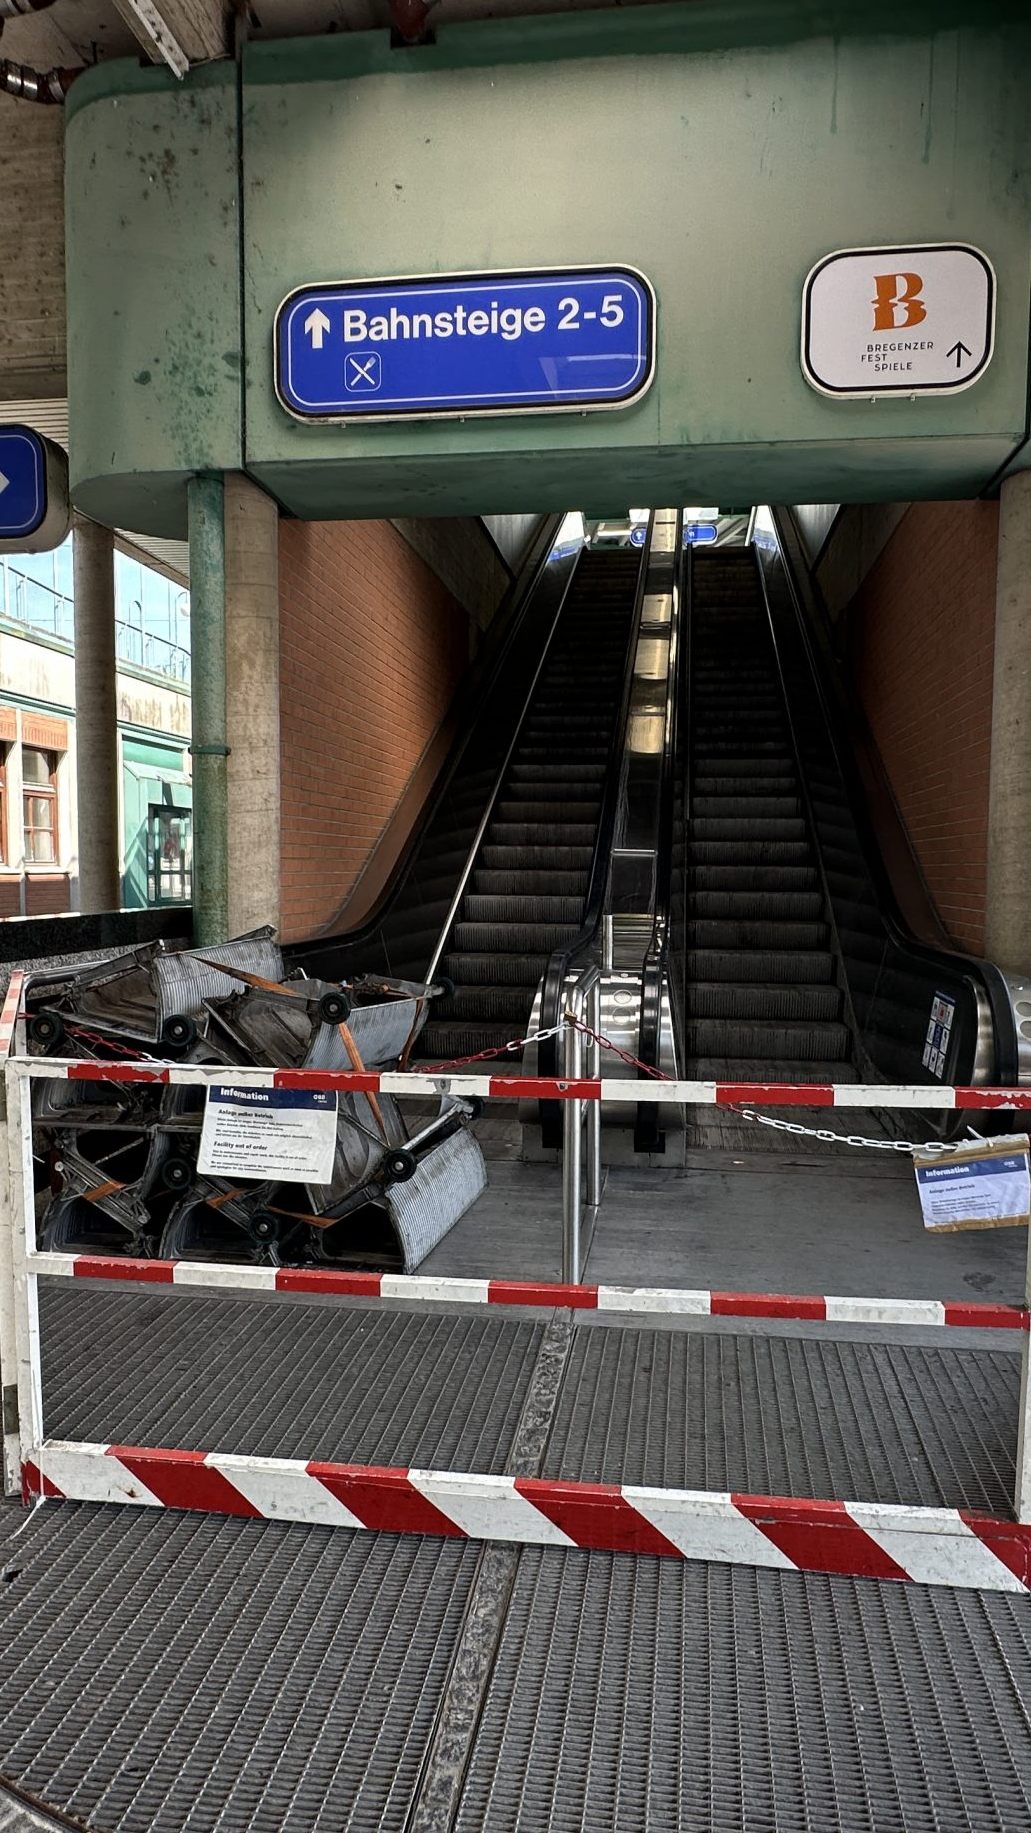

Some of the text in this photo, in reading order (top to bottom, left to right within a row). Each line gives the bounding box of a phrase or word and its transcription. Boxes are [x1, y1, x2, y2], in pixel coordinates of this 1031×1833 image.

[871, 272, 927, 331] B
[343, 295, 624, 342] Bahnsteige 2-5
[867, 341, 934, 353] BREGENZER
[861, 354, 888, 363] FEST
[874, 362, 913, 371] SPIELE
[220, 1087, 269, 1102] Information
[213, 1141, 234, 1149] Facility
[925, 1166, 970, 1177] Information
